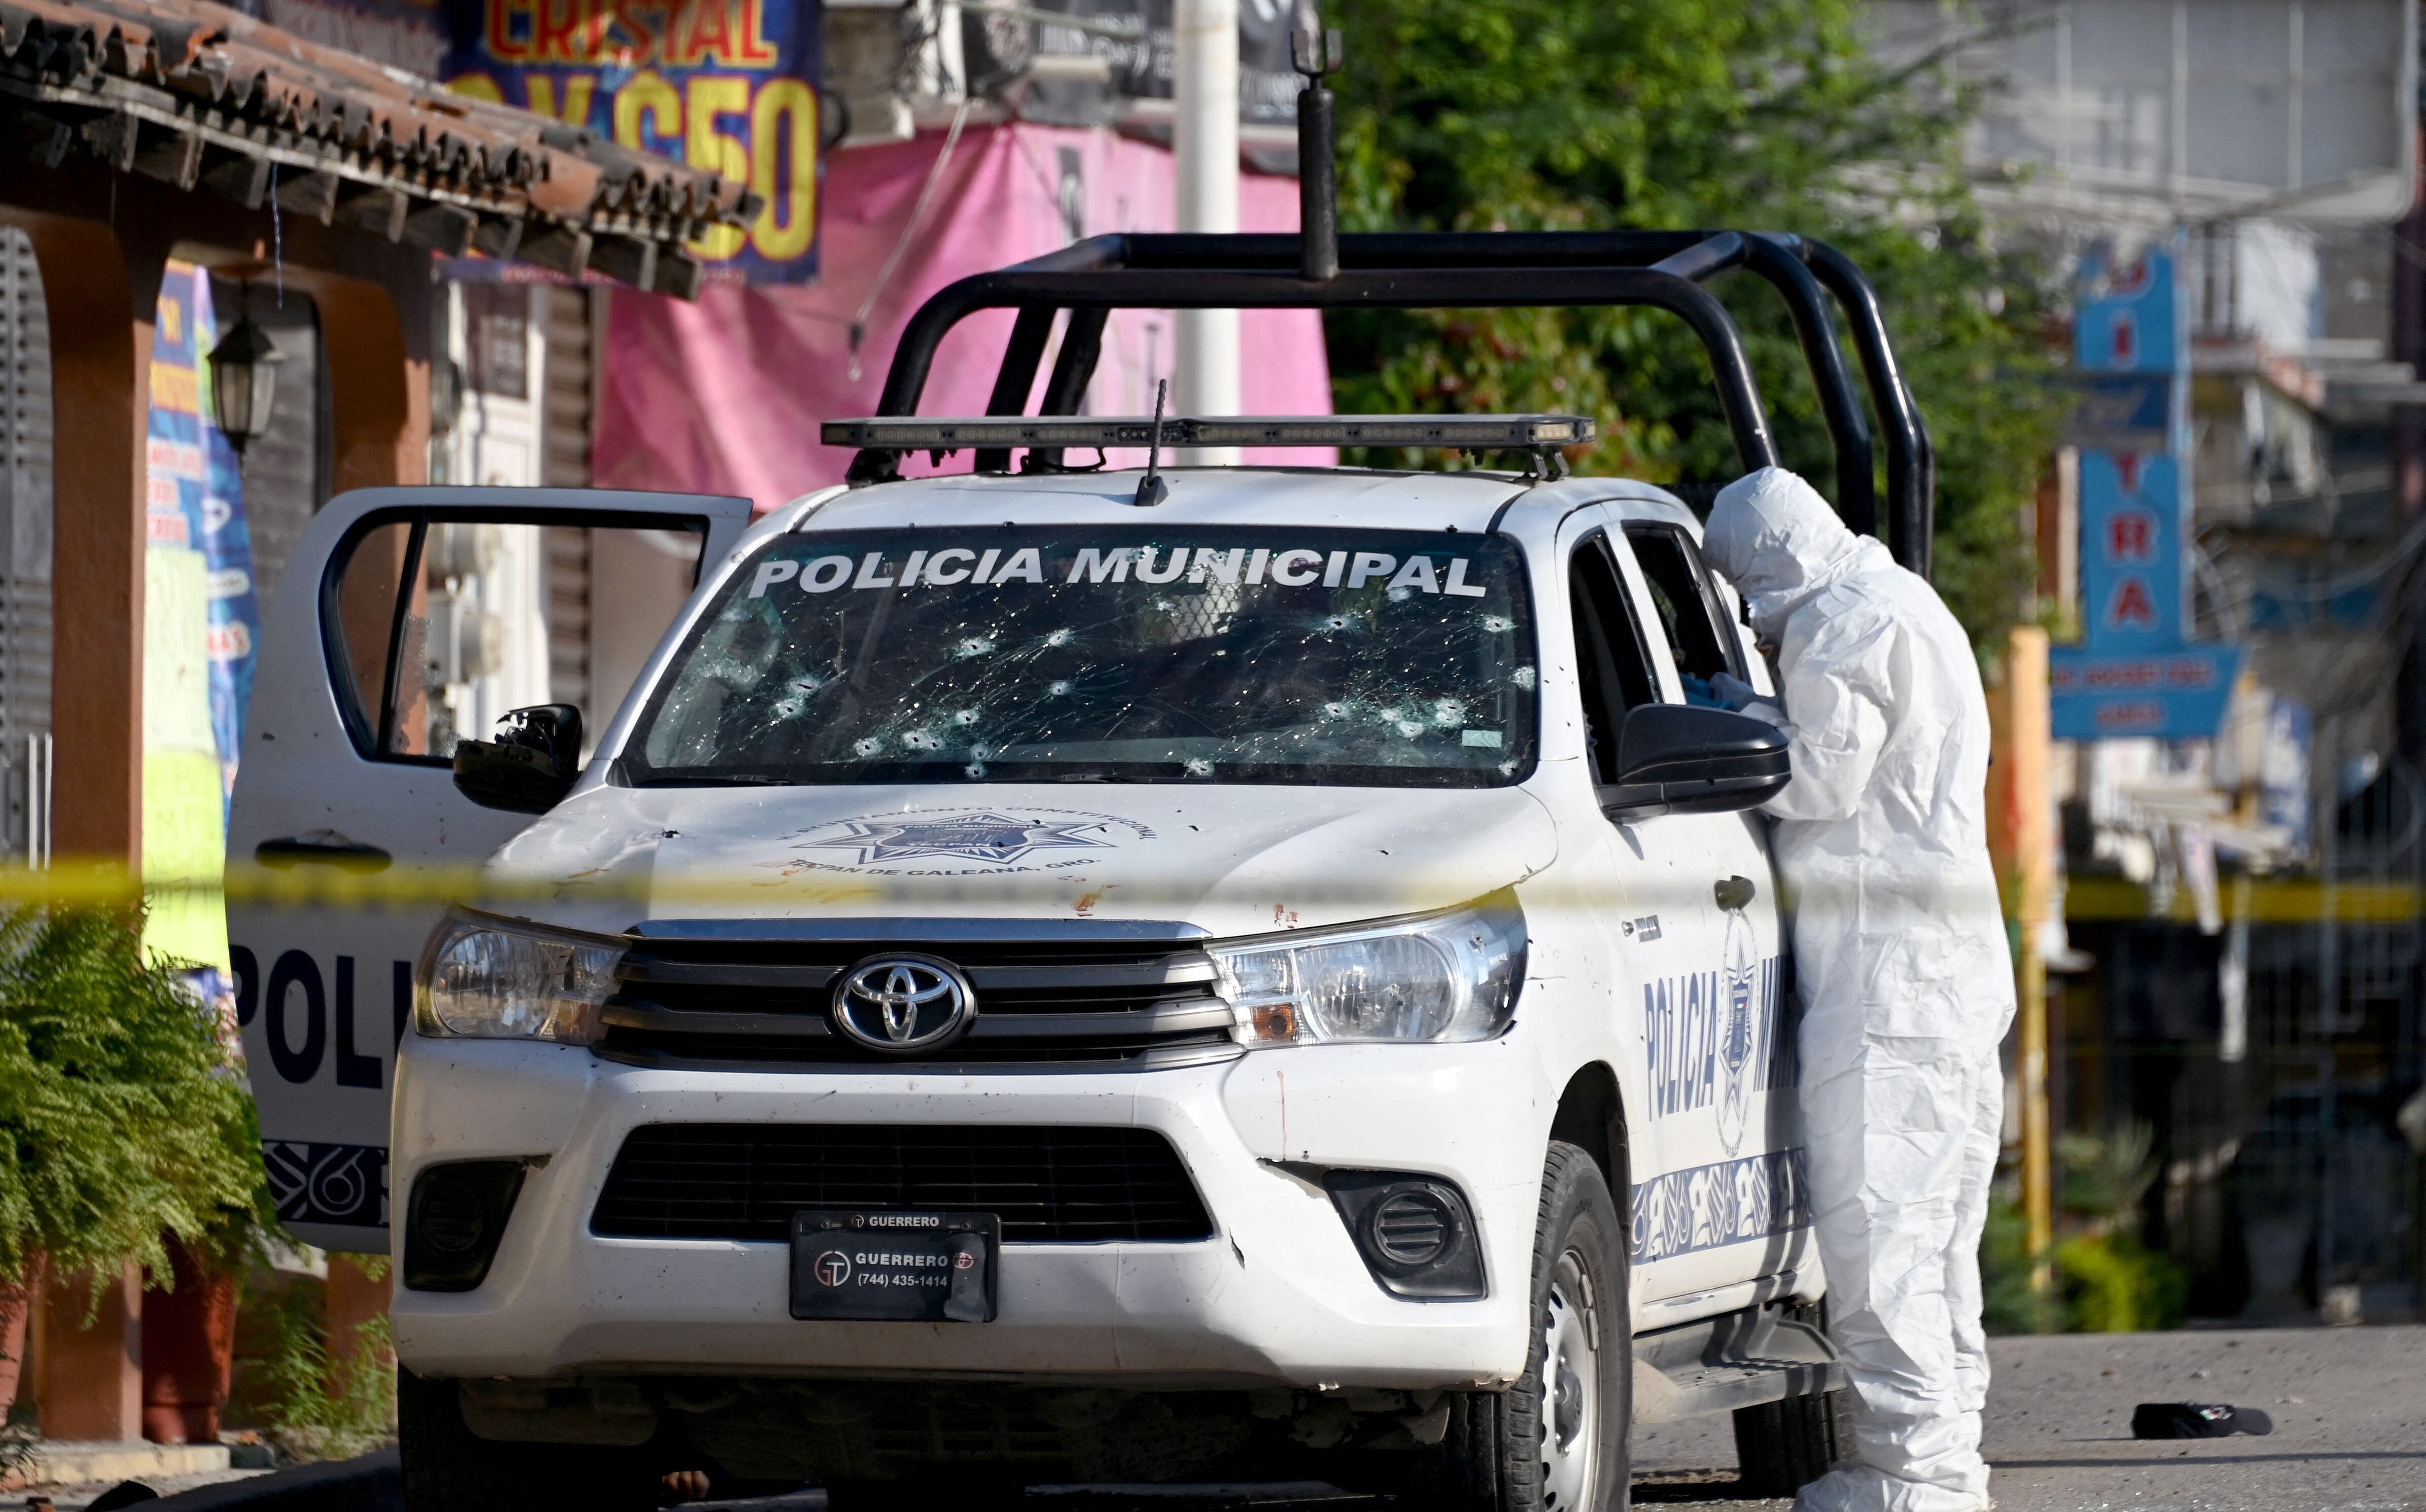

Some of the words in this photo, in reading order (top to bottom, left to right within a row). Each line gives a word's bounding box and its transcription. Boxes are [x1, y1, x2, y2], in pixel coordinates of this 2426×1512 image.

[486, 0, 778, 67] CRISTAL
[749, 548, 1043, 597] POLICIA
[1066, 547, 1486, 597] MUNICIPAL
[1006, 806, 1158, 840] CONSTITUCIONAL
[790, 859, 862, 873] TECPAN
[907, 866, 1040, 875] GALEANA,
[1644, 971, 1716, 1122] POLICIA
[869, 1216, 939, 1227] GUERRERO
[856, 1252, 948, 1267] GUERRERO
[858, 1273, 889, 1288] (744)
[892, 1274, 947, 1287] 435-1414
